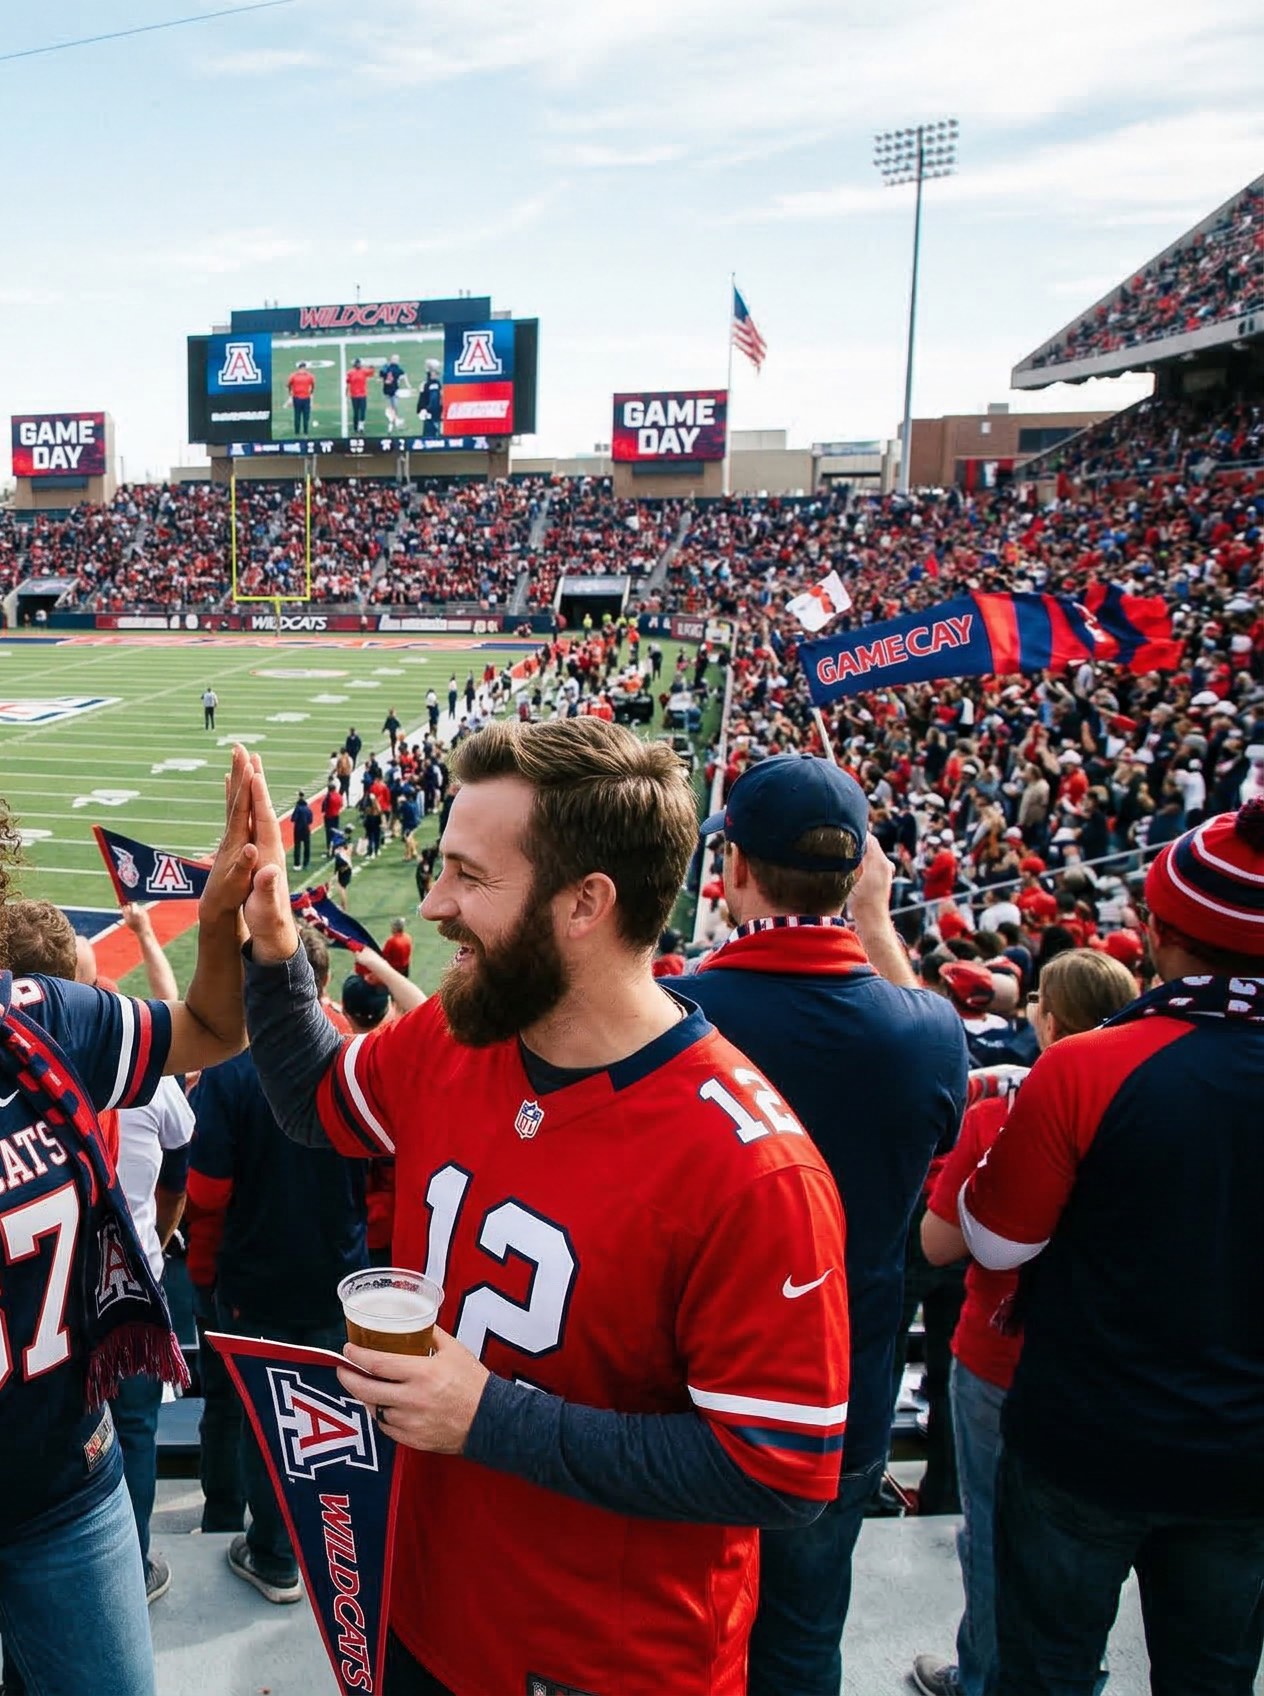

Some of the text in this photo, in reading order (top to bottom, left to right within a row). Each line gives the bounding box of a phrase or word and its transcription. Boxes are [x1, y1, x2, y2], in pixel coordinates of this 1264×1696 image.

[300, 302, 420, 330] WILDCATS
[218, 342, 262, 386] A
[454, 330, 502, 376] A
[19, 419, 96, 446] GAME
[623, 398, 716, 428] GAME
[32, 445, 84, 470] DAY
[638, 426, 701, 455] DAY
[251, 615, 328, 631] WILDCATS
[146, 850, 194, 894] A
[699, 1067, 804, 1145] 12
[425, 1160, 579, 1358] 12
[265, 1366, 379, 1480] A
[318, 1493, 372, 1694] WILDCATS
